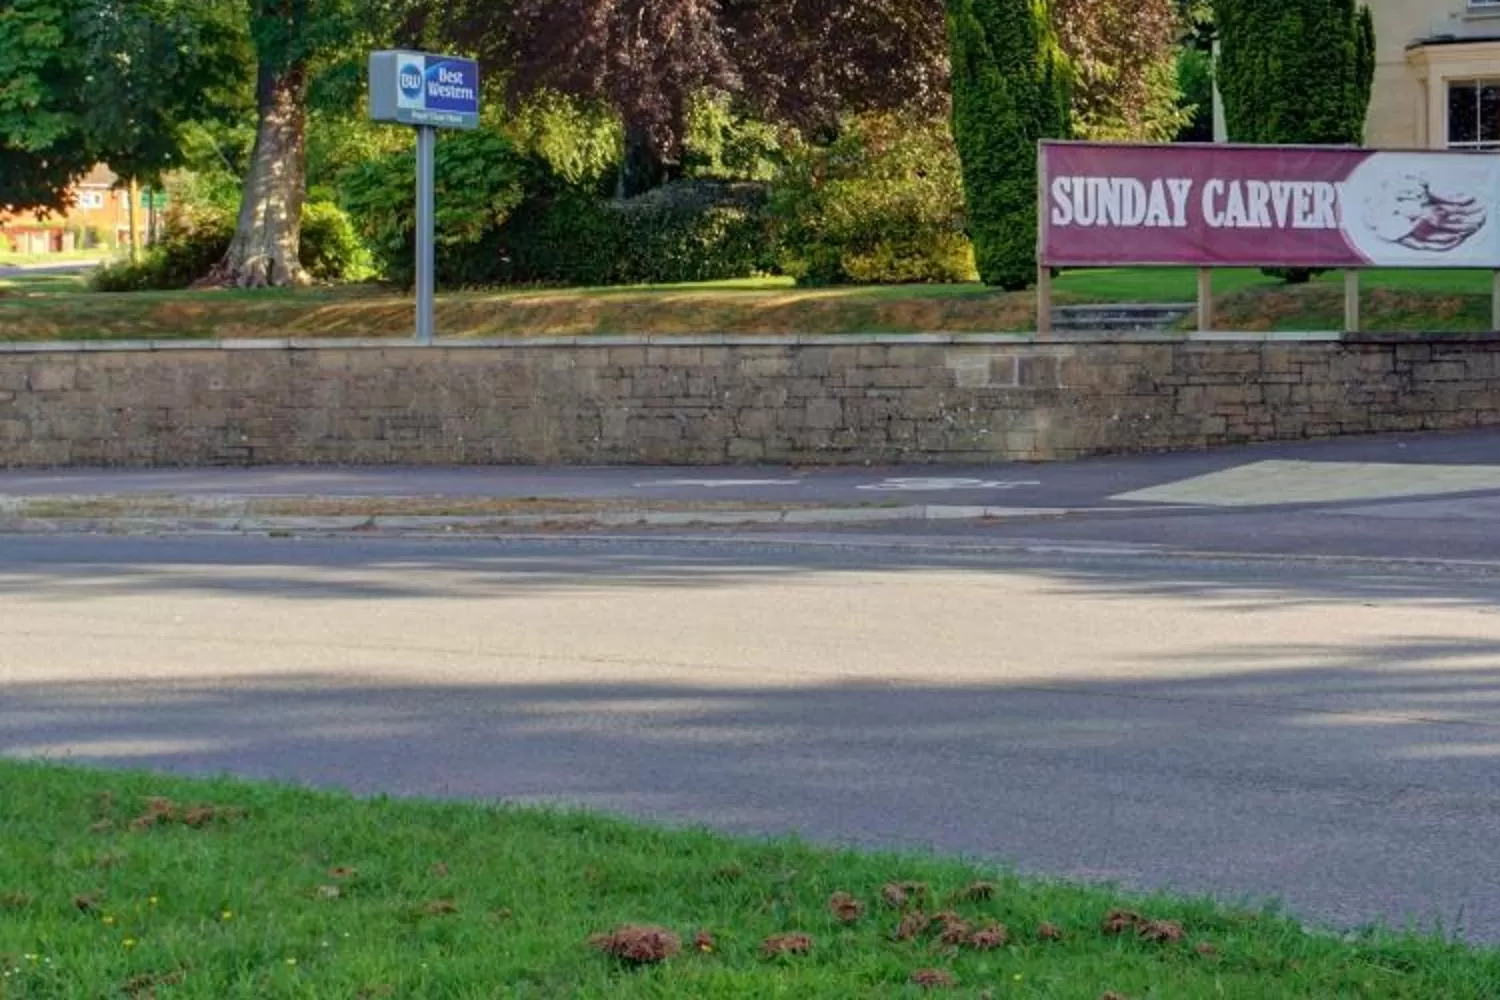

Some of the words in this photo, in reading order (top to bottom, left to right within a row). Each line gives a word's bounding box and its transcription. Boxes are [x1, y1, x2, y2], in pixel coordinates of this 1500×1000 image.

[439, 67, 463, 84] Best
[428, 81, 473, 100] Western
[1051, 176, 1193, 227] SUNDAY
